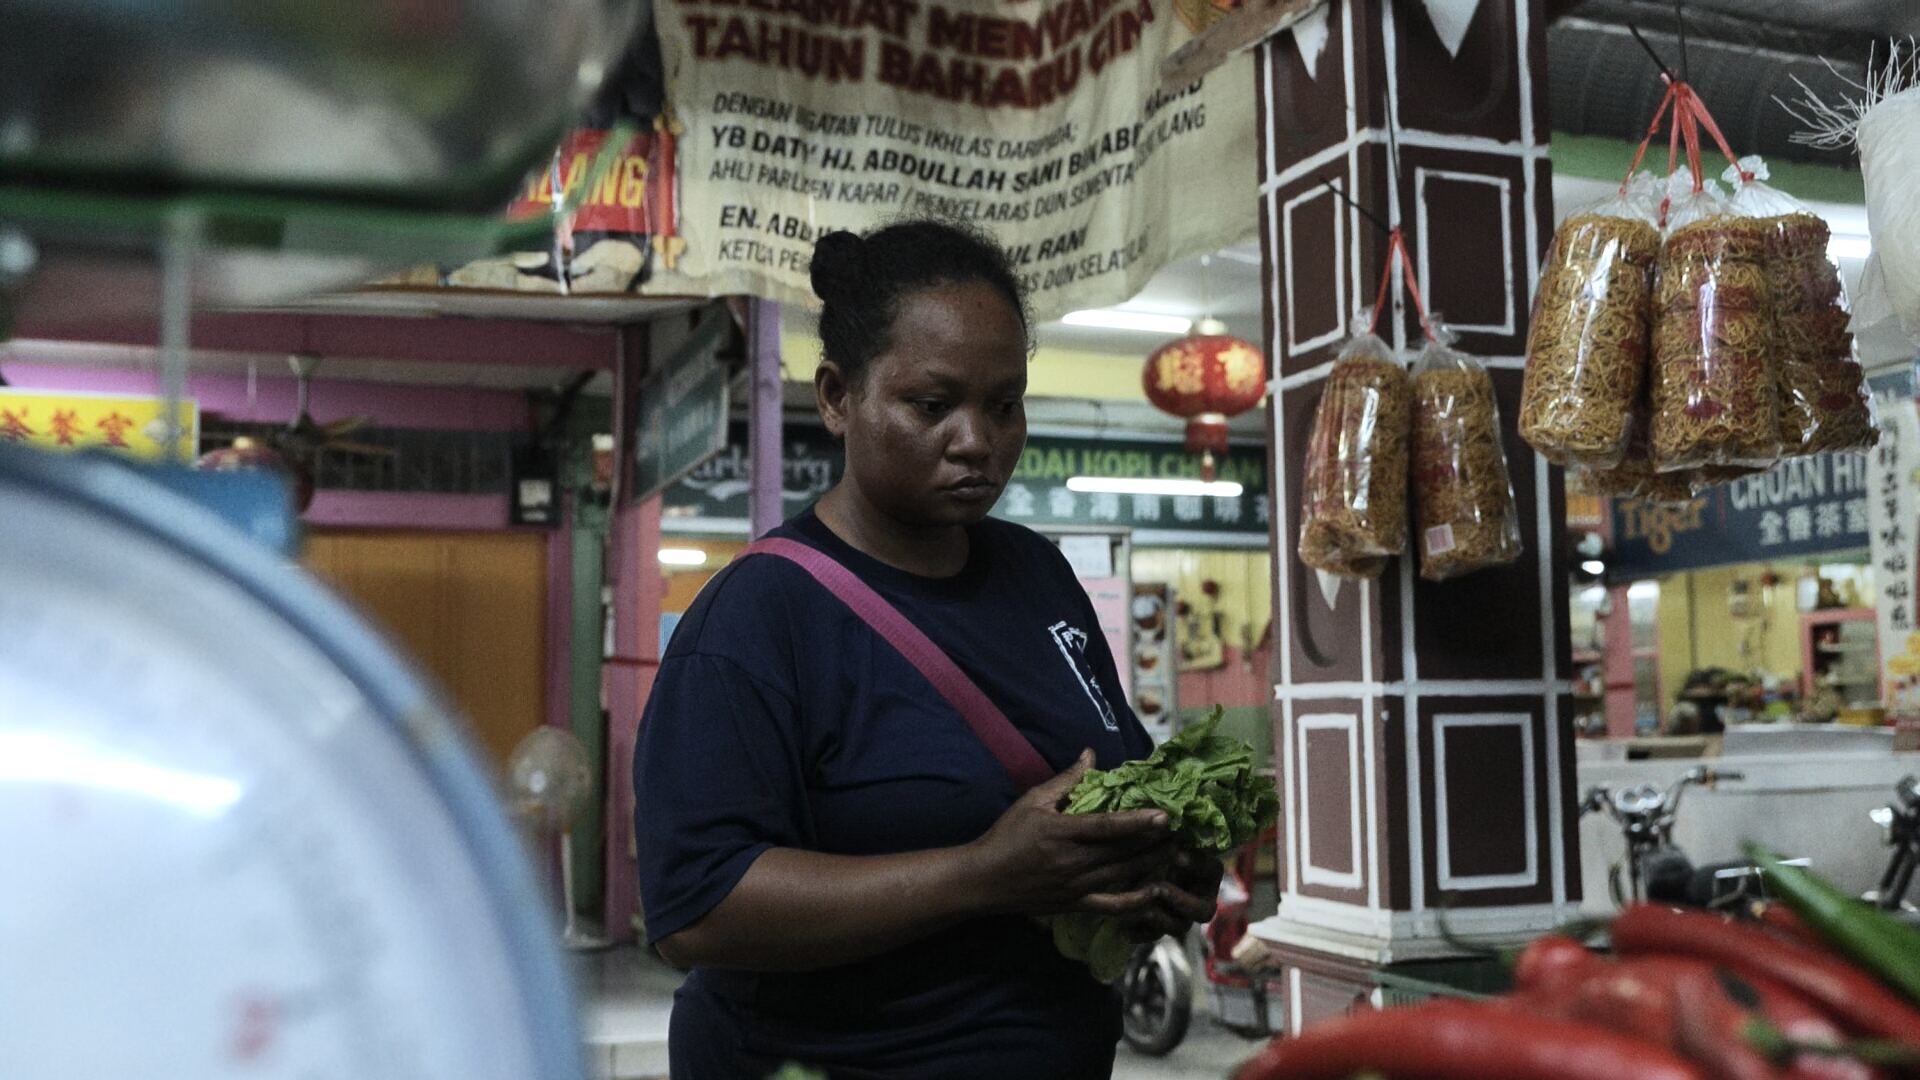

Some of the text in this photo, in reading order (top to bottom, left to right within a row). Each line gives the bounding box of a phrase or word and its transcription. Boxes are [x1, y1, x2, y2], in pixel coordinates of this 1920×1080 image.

[686, 15, 863, 83] TAHUN
[877, 40, 1081, 110] BAHARU
[712, 92, 791, 123] DENGAN
[864, 113, 922, 146] TULUS
[924, 130, 991, 159] IKHLAS
[709, 158, 754, 182] AHLI
[838, 182, 900, 204] KAPAR
[712, 126, 746, 148] YB
[821, 146, 856, 172] HJ.
[863, 149, 1005, 193] ABDULLAH
[1012, 158, 1062, 193] SANI
[720, 204, 761, 230] EN.
[1036, 225, 1089, 262] RANI
[1159, 450, 1264, 487] CHAN
[1730, 454, 1826, 512] CHUAN
[1617, 498, 1707, 554] Tiger
